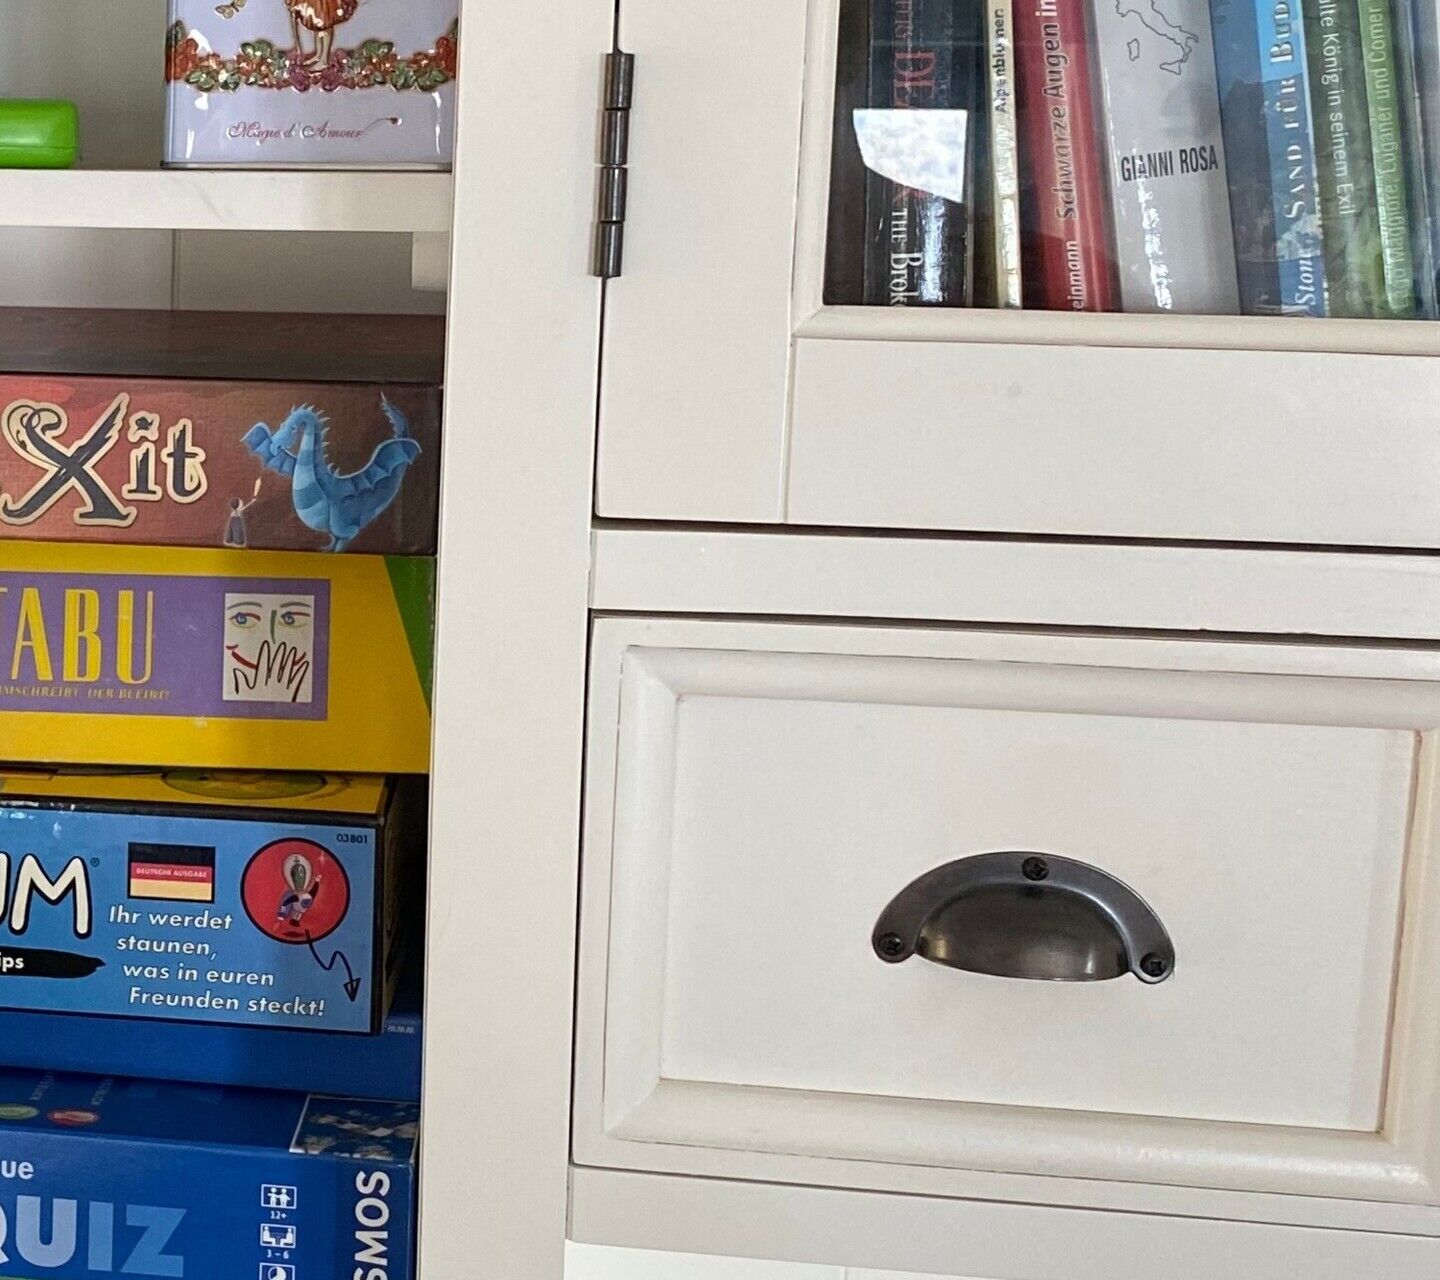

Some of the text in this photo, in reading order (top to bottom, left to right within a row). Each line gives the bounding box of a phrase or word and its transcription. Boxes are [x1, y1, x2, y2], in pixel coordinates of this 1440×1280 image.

[1042, 23, 1071, 101] Augen
[1321, 31, 1341, 85] König
[1326, 89, 1342, 107] in
[1052, 103, 1077, 220] Schwarze
[1330, 113, 1348, 179] seinem
[1120, 144, 1219, 182] GIANNI ROSA
[1336, 182, 1356, 215] Exil
[173, 868, 208, 880] AUSGABE
[109, 905, 233, 930] Ihr werdet
[116, 934, 218, 961] staunen,
[122, 962, 275, 988] was in euren
[129, 985, 326, 1017] Freunden steckt!
